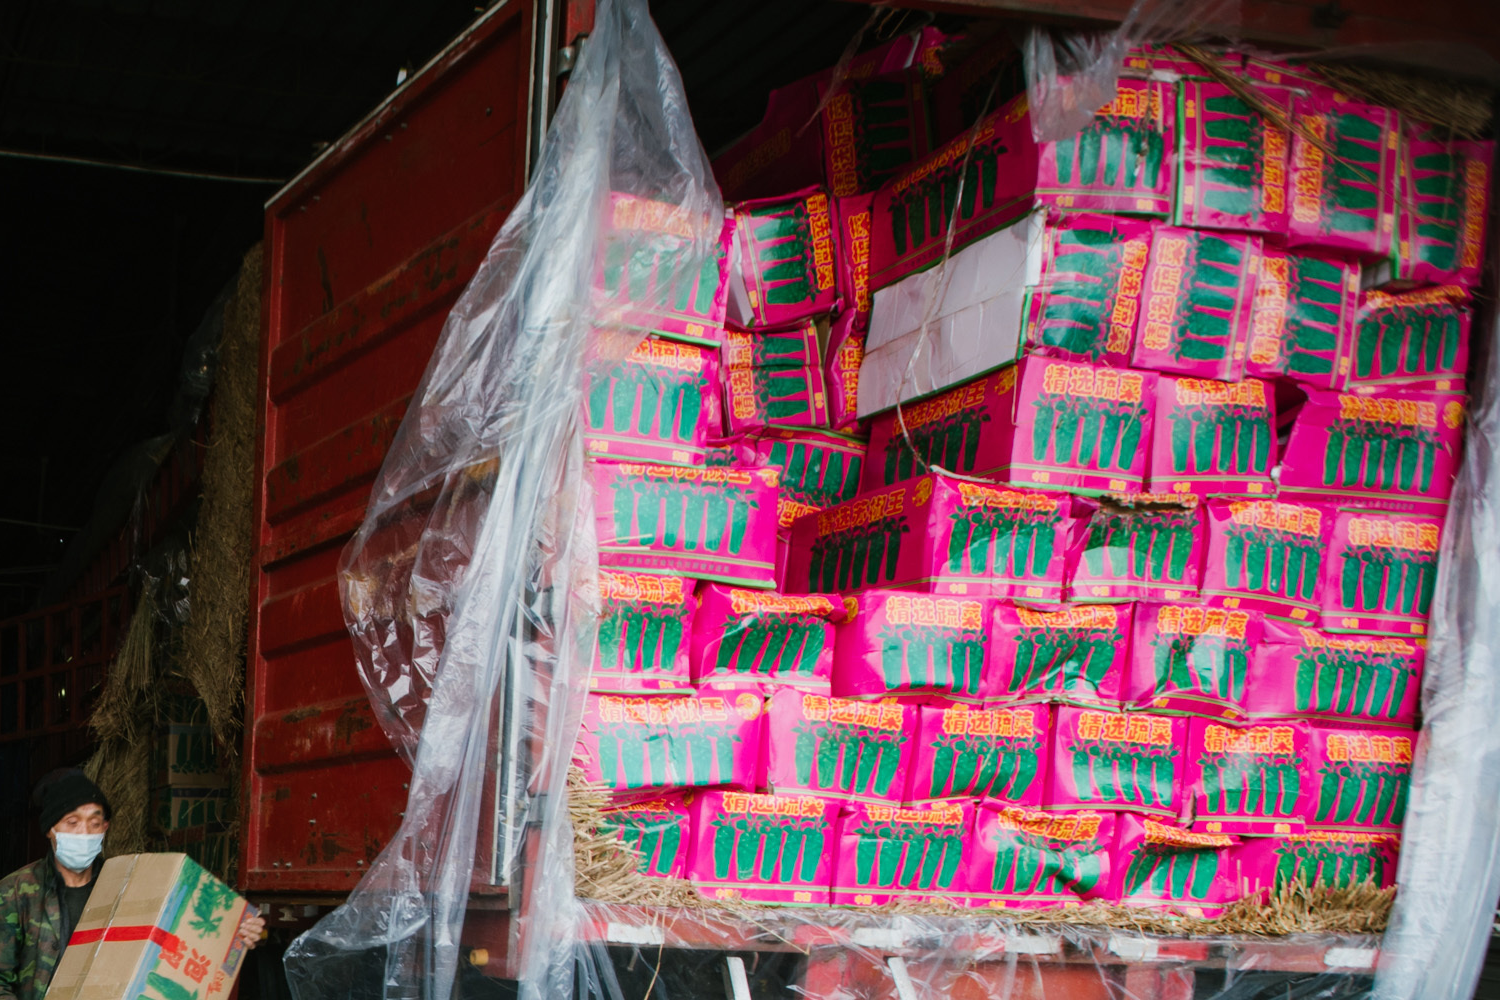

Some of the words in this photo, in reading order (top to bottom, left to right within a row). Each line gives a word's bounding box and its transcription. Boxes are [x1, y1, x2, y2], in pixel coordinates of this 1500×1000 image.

[1106, 240, 1148, 356] 精选蔬菜
[1143, 237, 1187, 351] 精选蔬菜
[1044, 363, 1143, 402] 精选蔬菜
[1176, 378, 1267, 407] 精选蔬菜
[1229, 501, 1322, 537] 精选蔬菜
[1348, 517, 1439, 552] 精选蔬菜
[887, 597, 983, 630] 精选蔬菜
[1158, 605, 1249, 640] 精选蔬菜
[598, 696, 727, 724] 精选苏椒王
[802, 695, 904, 731] 精选蔬菜
[944, 709, 1034, 737] 精选蔬菜
[1078, 712, 1173, 745] 精选蔬菜
[1204, 724, 1294, 754] 精选蔬菜
[1327, 733, 1412, 763] 精选蔬菜
[998, 807, 1102, 841] 精选蔬菜
